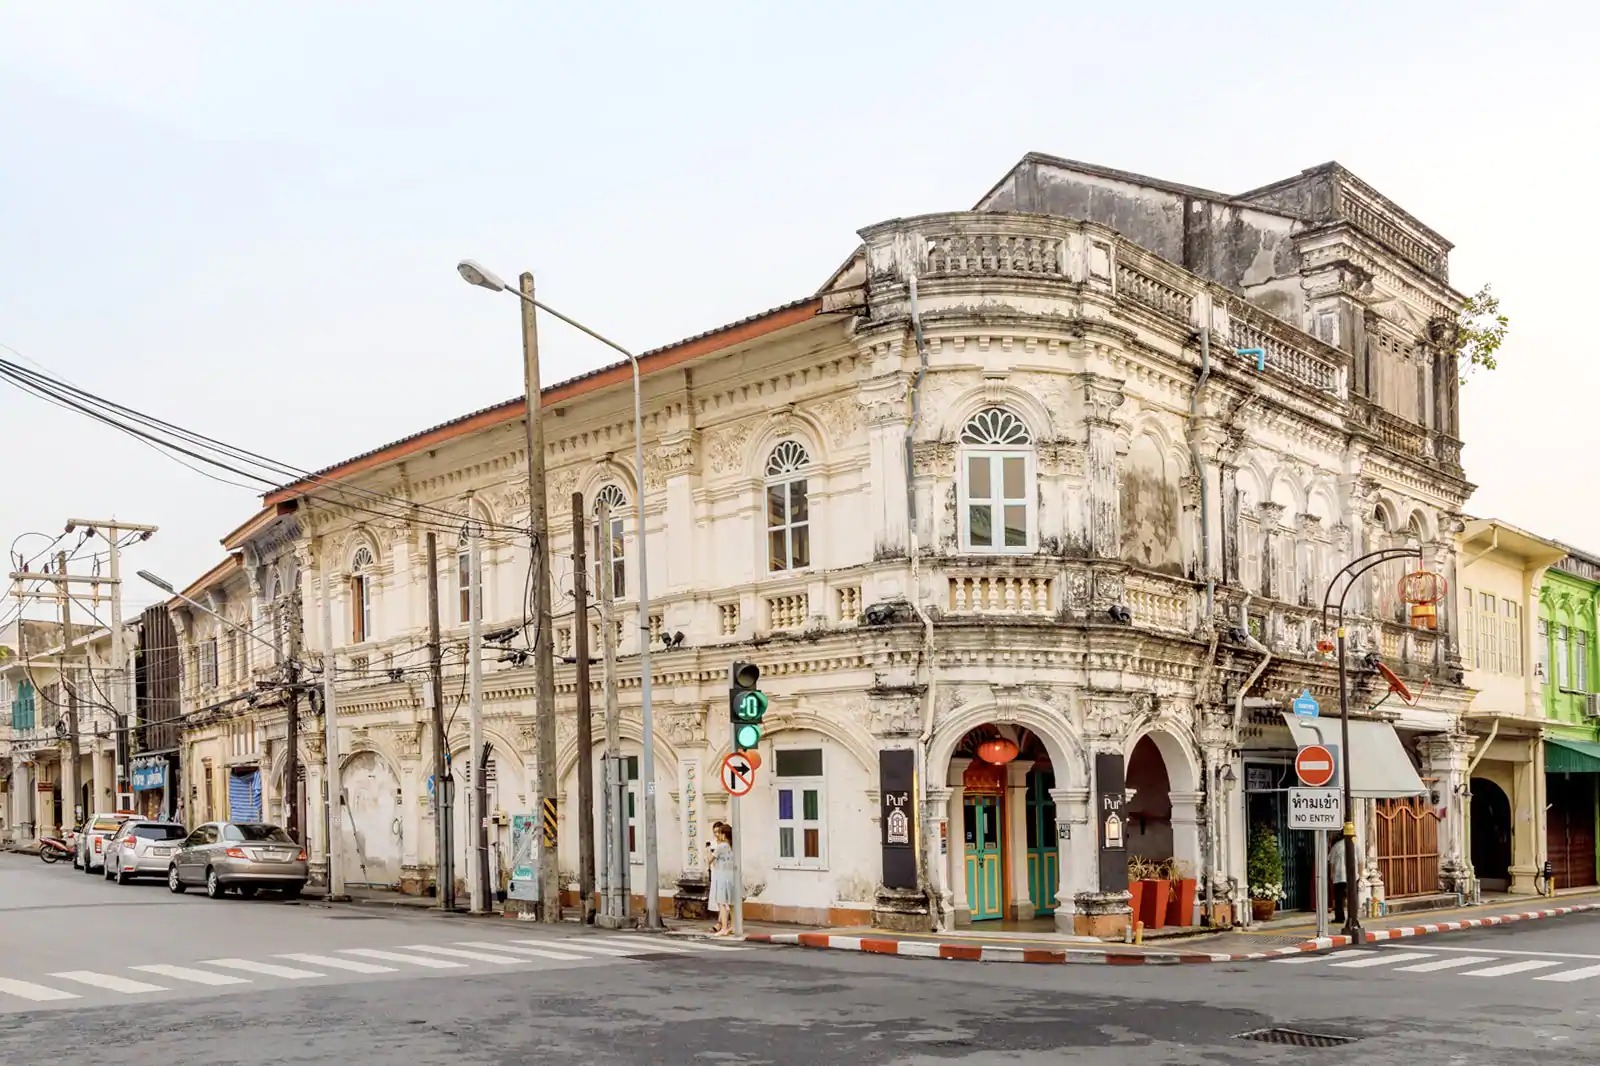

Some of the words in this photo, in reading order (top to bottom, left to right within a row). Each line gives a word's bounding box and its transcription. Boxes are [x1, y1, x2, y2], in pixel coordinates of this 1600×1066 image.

[1292, 792, 1339, 809] ห้ามเข้า
[1295, 814, 1307, 822] NO
[1309, 814, 1335, 822] ENTRY
